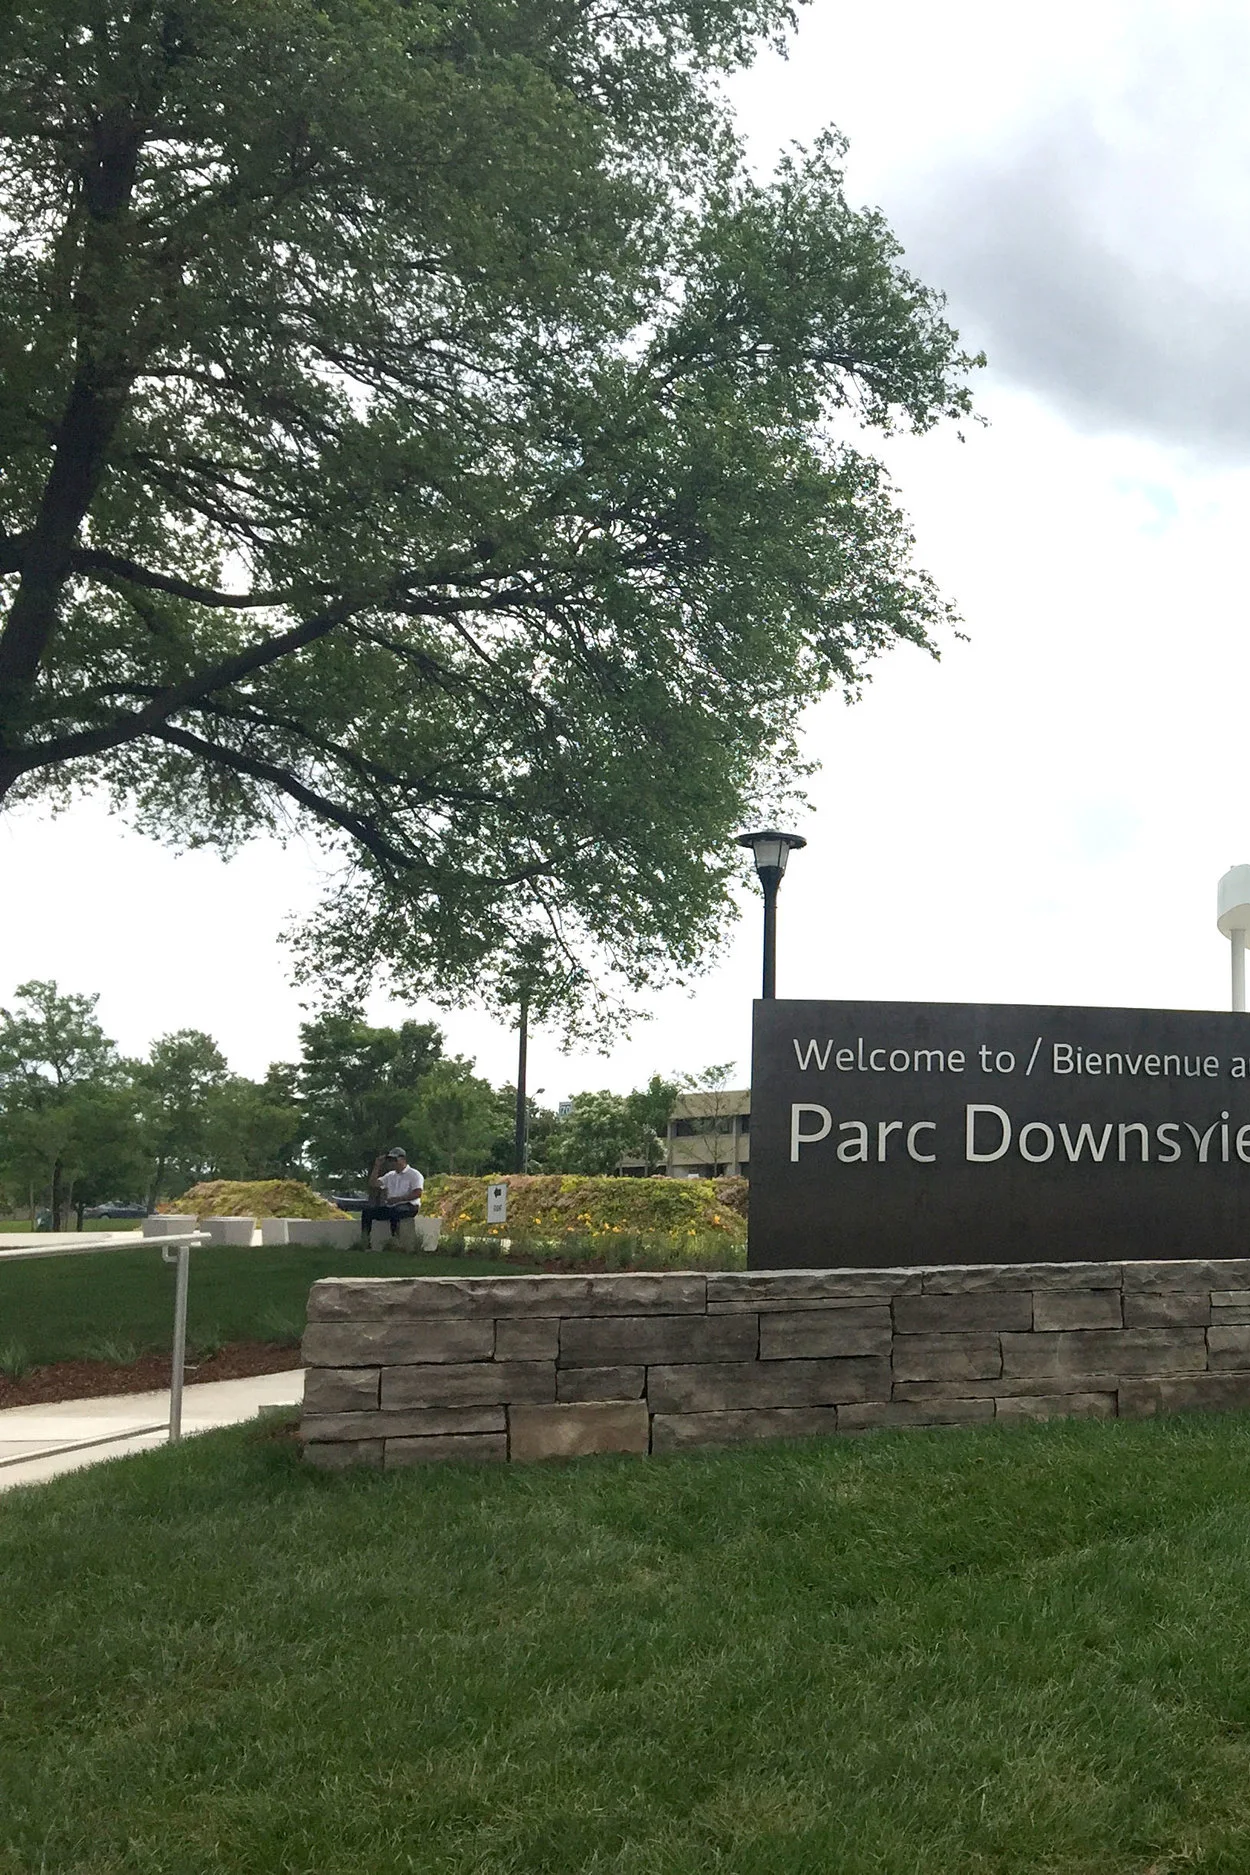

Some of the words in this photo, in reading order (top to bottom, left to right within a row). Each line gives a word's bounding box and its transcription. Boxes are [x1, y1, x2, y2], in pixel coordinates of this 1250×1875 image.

[793, 1037, 966, 1073] Welcome
[979, 1042, 1016, 1074] to
[1052, 1043, 1220, 1078] Bienvenue
[790, 1103, 937, 1163] Parc
